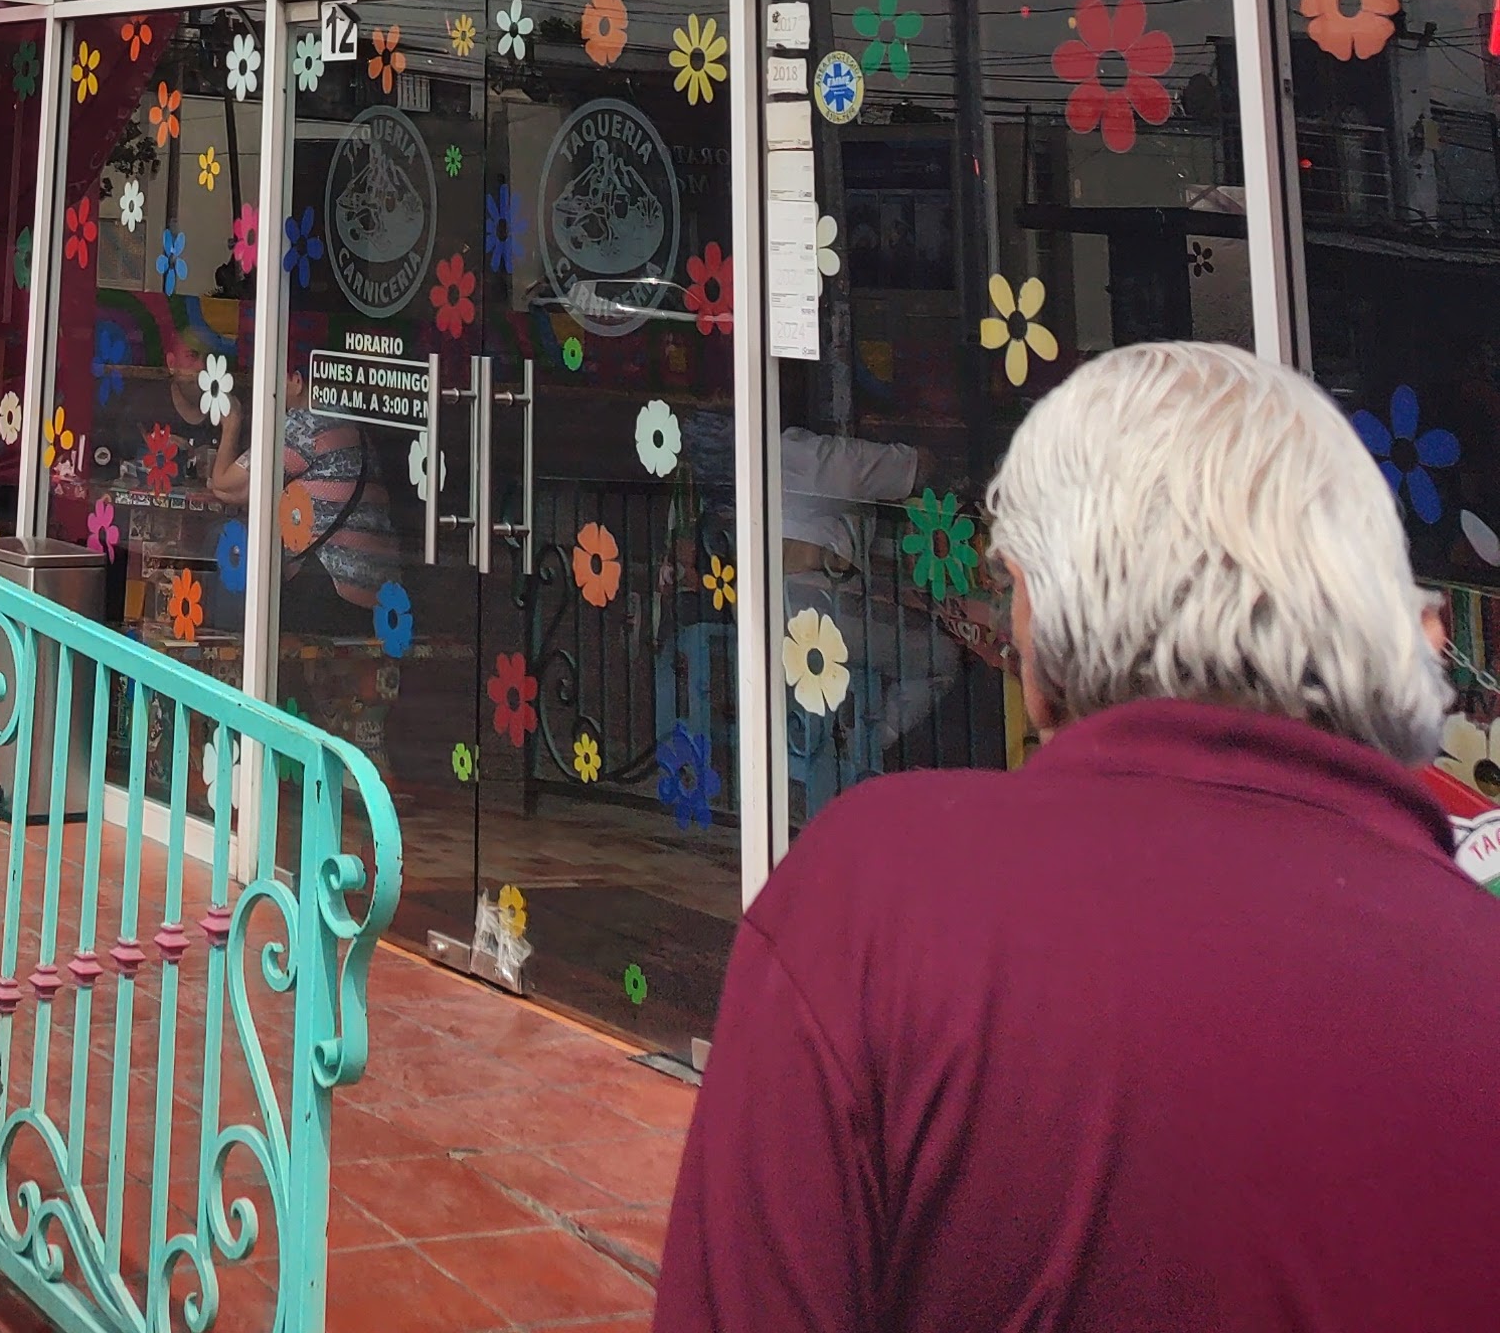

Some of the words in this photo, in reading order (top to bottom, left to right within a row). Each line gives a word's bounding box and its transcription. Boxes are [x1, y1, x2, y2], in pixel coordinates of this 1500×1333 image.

[773, 66, 799, 82] 2018
[343, 119, 417, 164] TAQUERIA
[560, 114, 653, 164] TAQUERIA
[338, 247, 421, 305] CARNICERIA
[345, 332, 404, 355] HORARIO
[313, 361, 353, 382] LUNES
[355, 366, 366, 385] A
[368, 368, 430, 393] DOMINGO
[312, 385, 338, 406] 8:00
[339, 389, 367, 410] A.M.
[369, 393, 379, 412] A
[382, 395, 409, 415] 3:00
